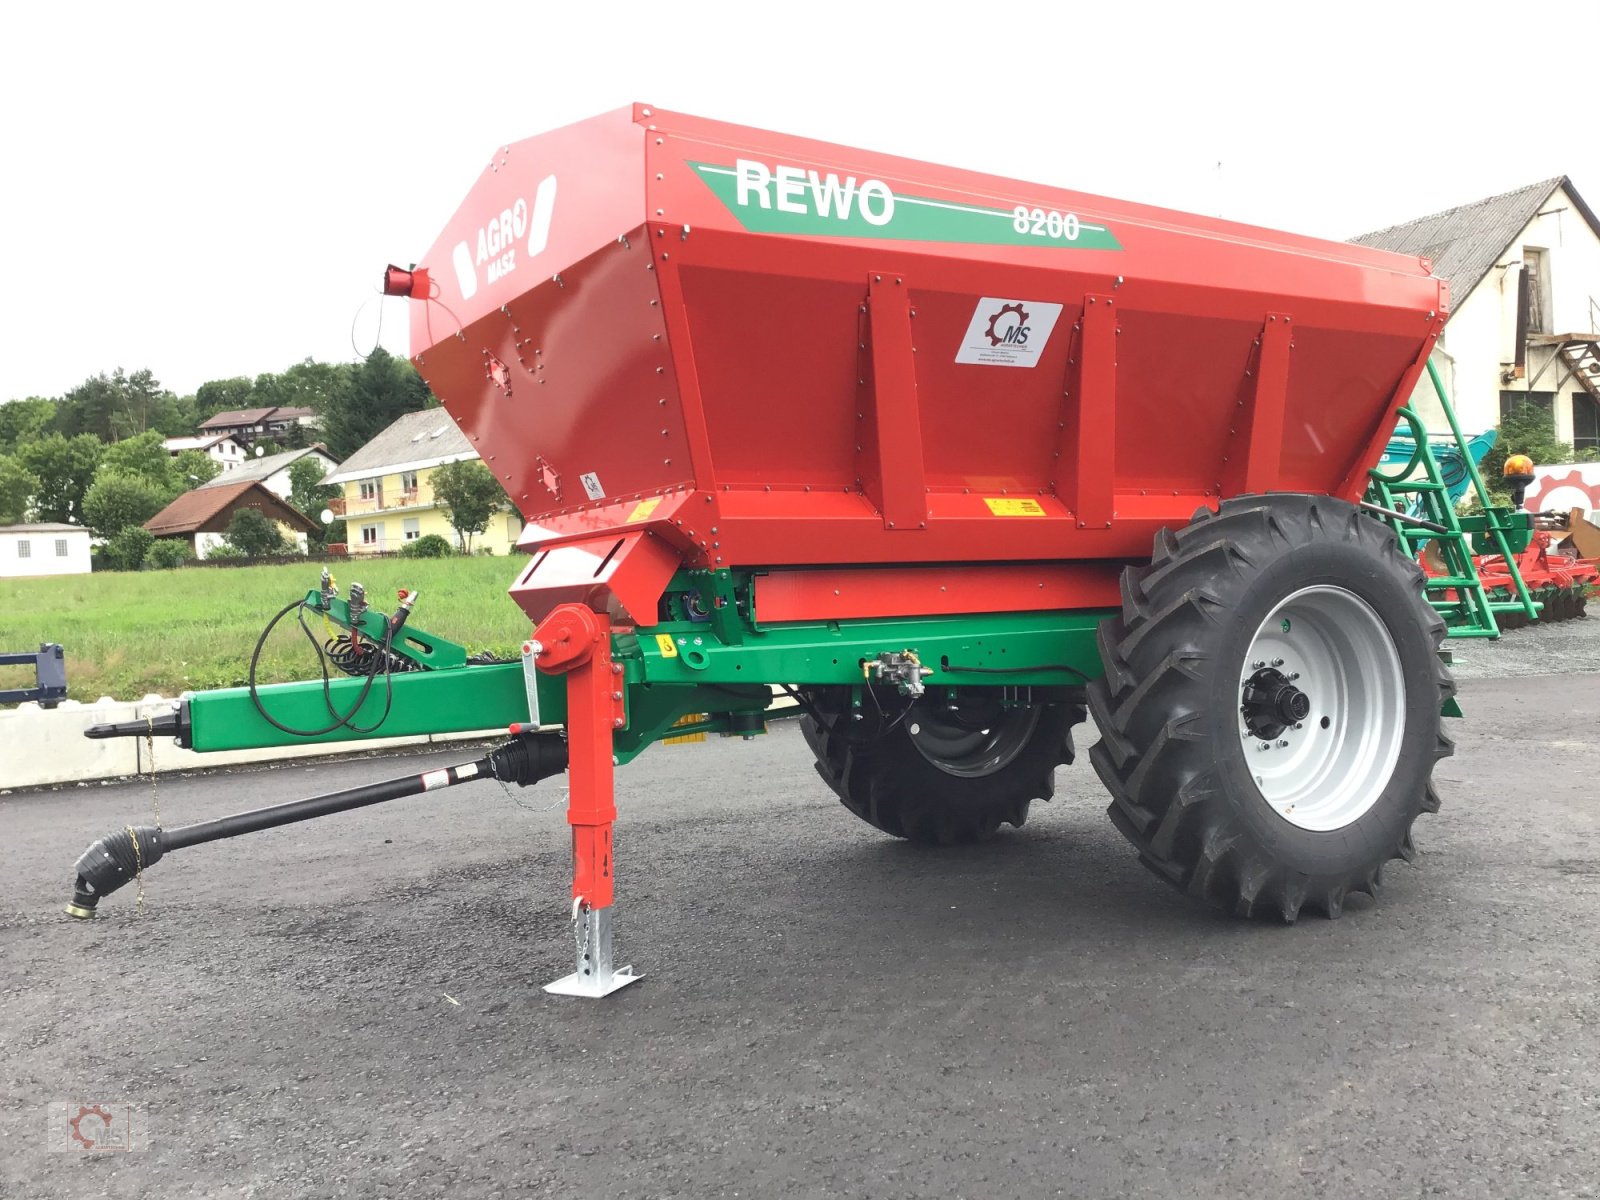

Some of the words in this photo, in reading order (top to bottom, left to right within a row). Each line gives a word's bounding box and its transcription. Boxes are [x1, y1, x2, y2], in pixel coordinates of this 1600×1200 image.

[736, 159, 894, 226] REWO
[476, 198, 527, 266] AGRO
[1013, 206, 1080, 241] 8200
[488, 249, 516, 285] MASZ
[1002, 325, 1031, 345] MS
